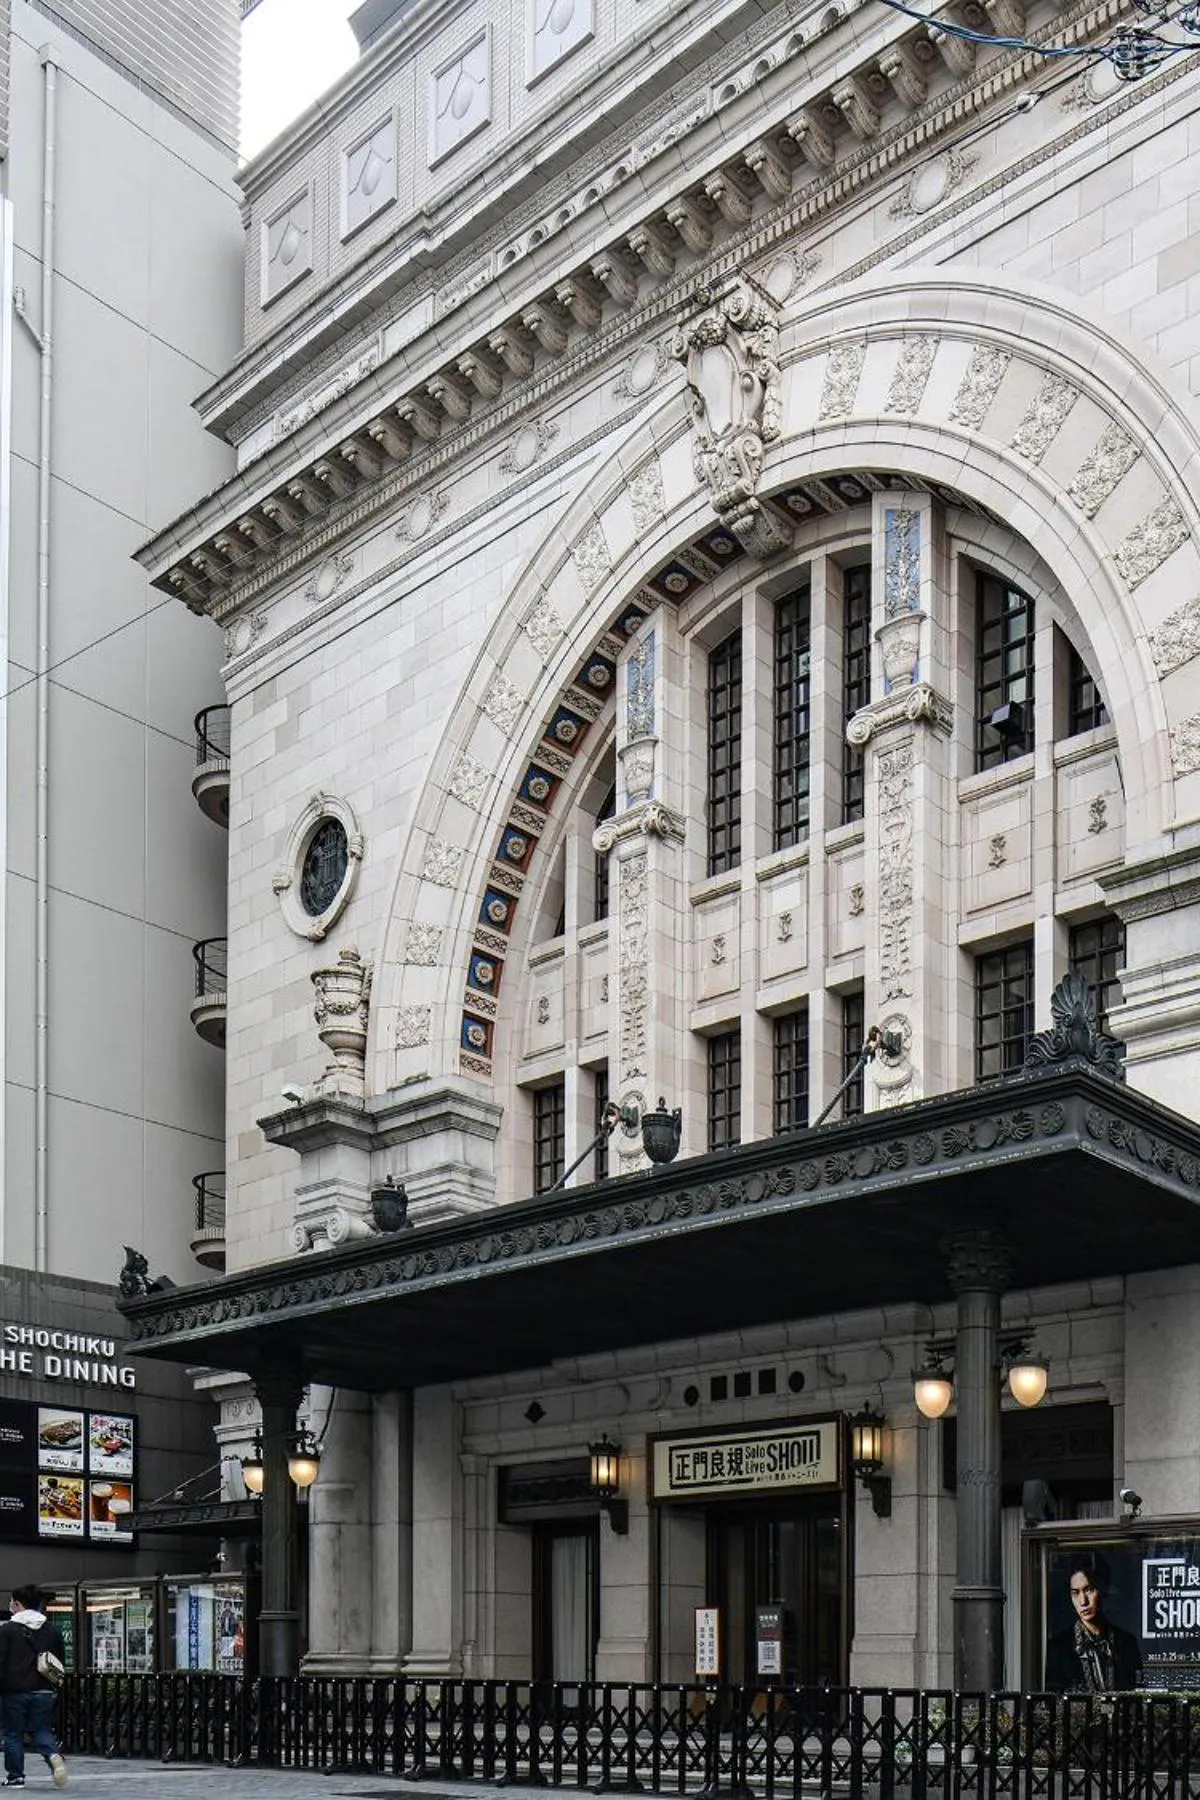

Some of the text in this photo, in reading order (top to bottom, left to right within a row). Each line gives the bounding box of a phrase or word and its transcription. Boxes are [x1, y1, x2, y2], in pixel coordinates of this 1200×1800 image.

[4, 1325, 115, 1357] SHOCHIKU
[45, 1355, 136, 1388] DINING
[675, 1447, 744, 1481] 正門良規
[745, 1445, 766, 1460] Solo
[745, 1460, 766, 1475] Live
